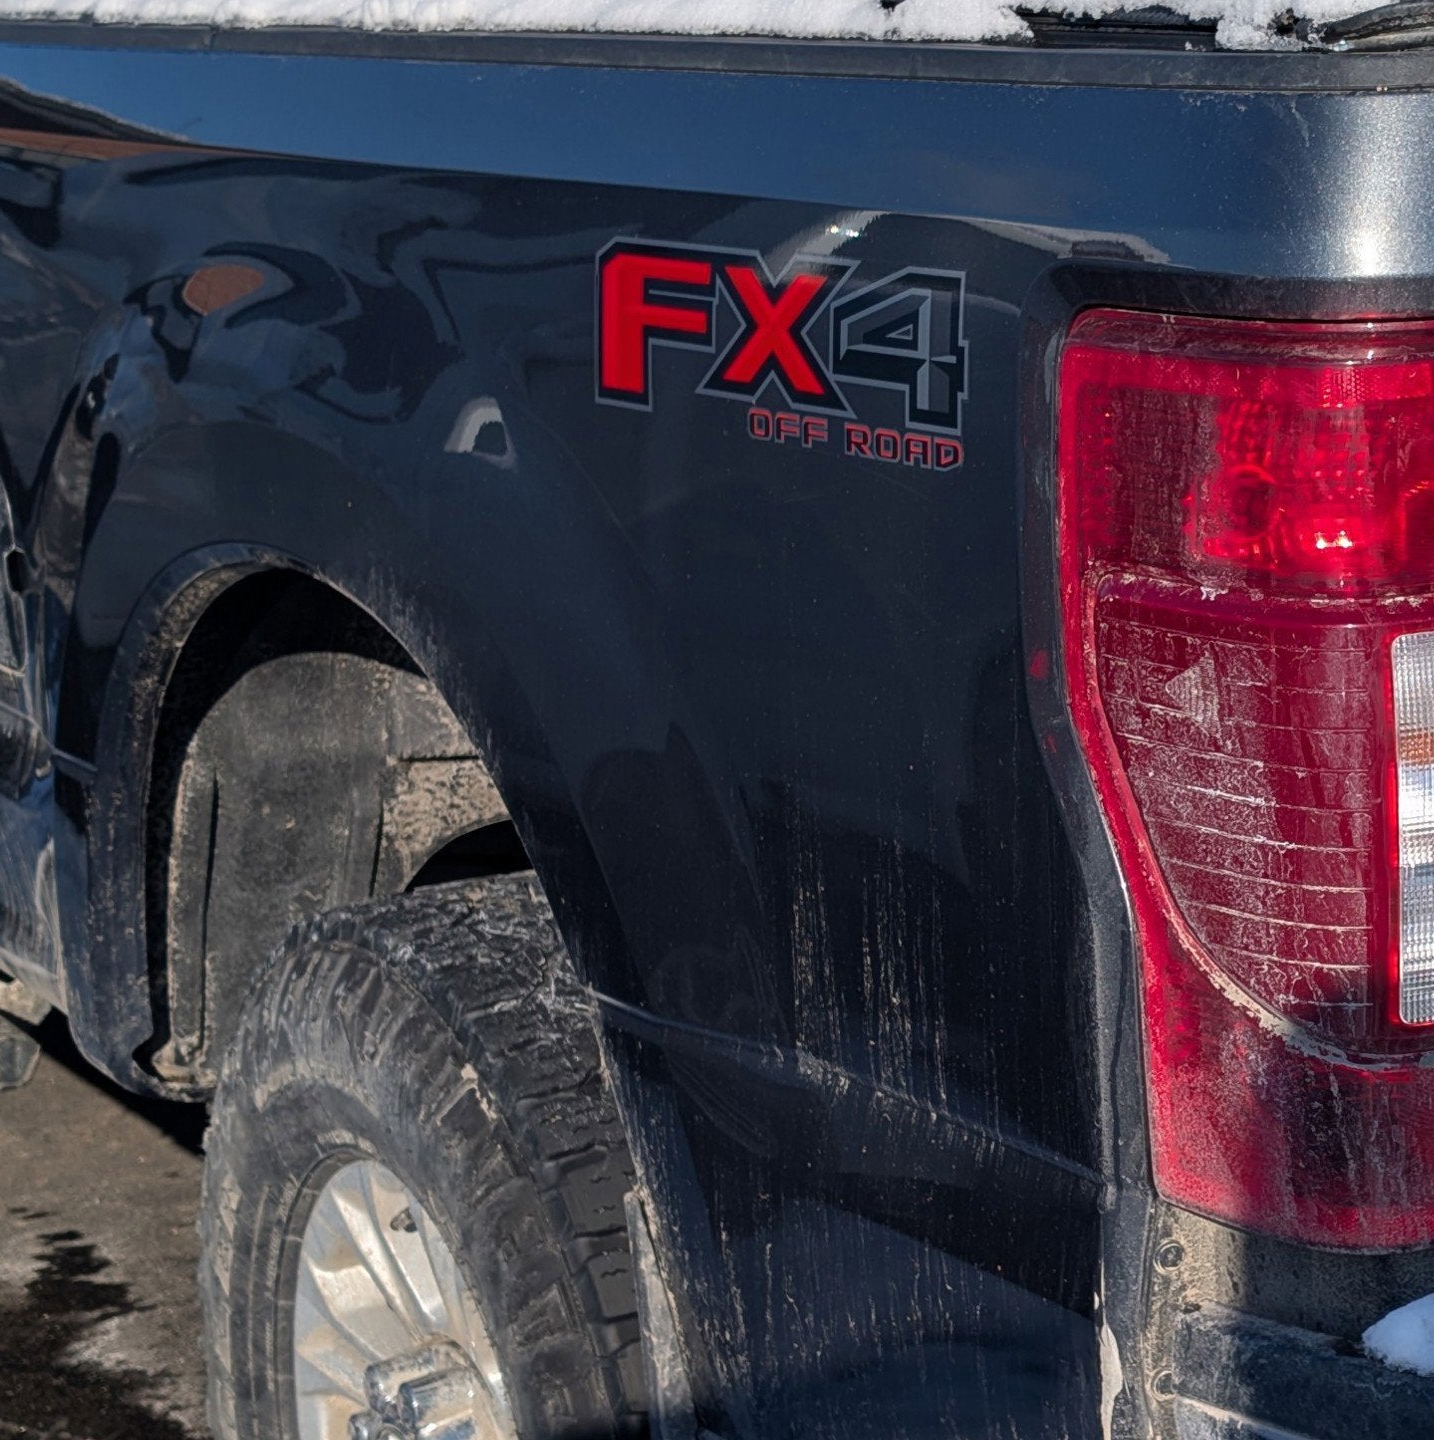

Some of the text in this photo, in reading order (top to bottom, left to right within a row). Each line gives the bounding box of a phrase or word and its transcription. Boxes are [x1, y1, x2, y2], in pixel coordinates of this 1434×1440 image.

[594, 236, 970, 436] FX4
[747, 407, 966, 473] OFF ROAD
